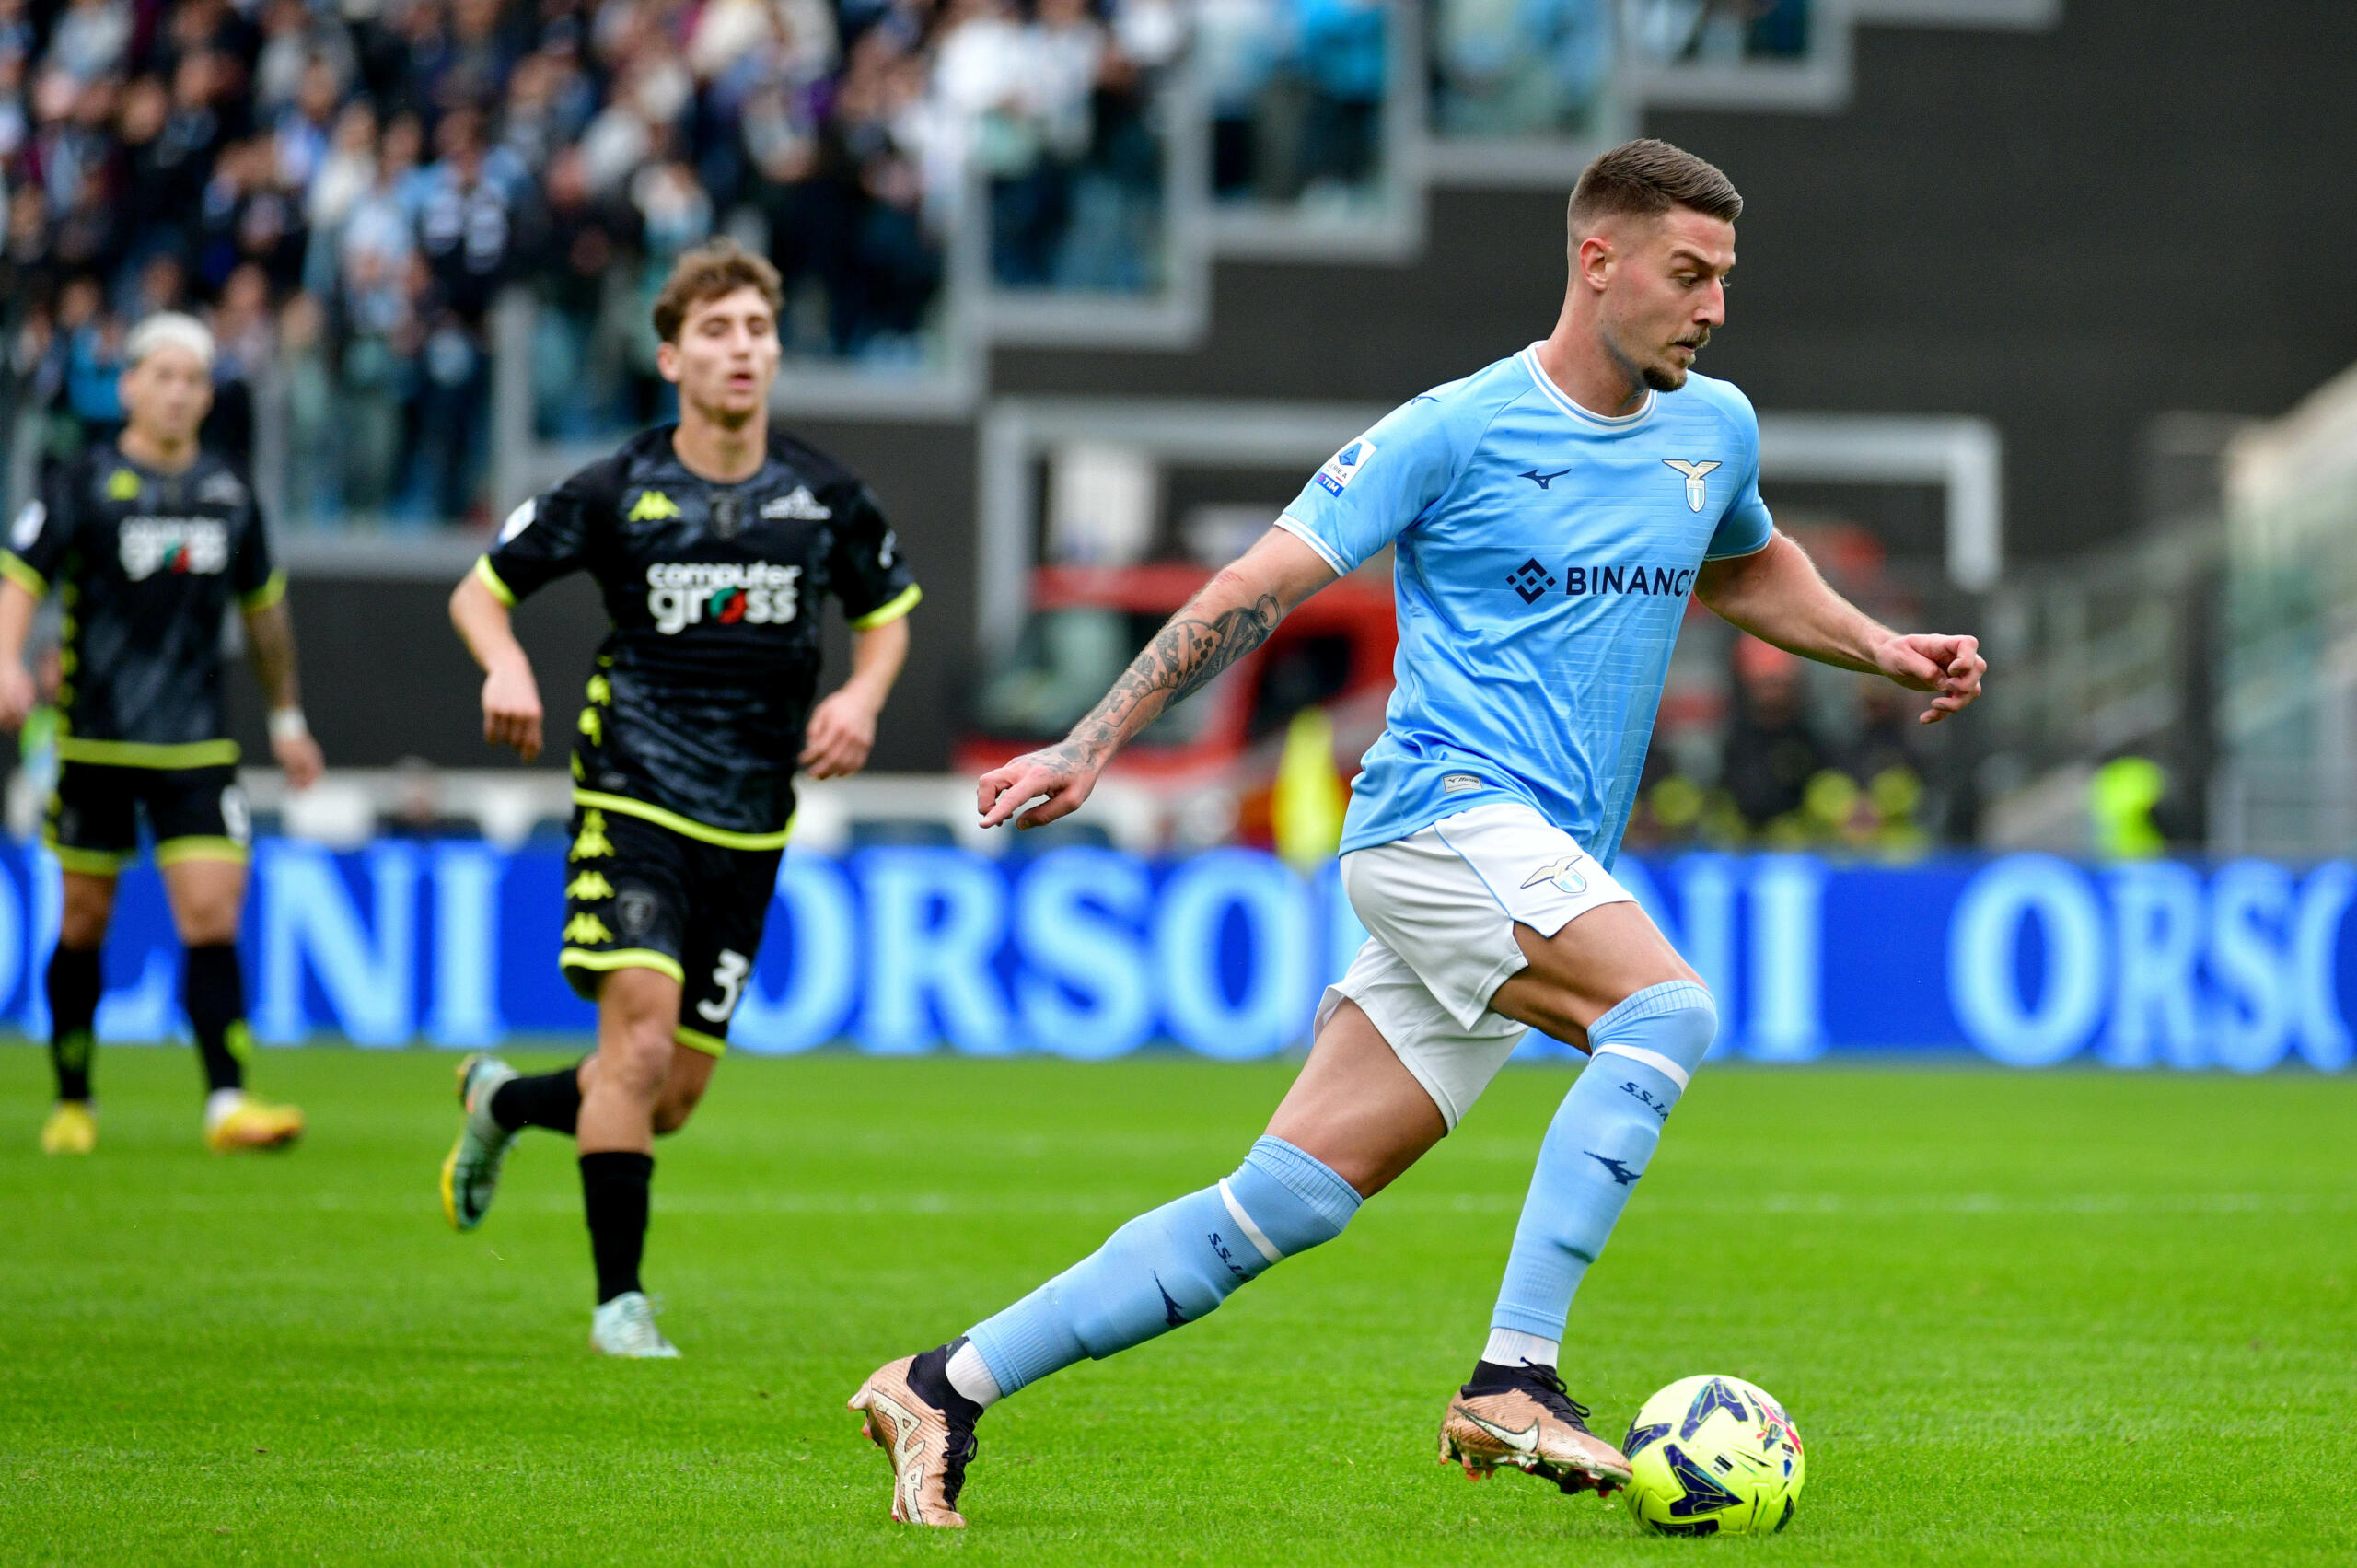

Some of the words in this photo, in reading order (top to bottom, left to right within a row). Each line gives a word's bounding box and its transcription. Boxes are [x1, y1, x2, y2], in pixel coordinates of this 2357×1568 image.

[1322, 477, 1340, 493] TIM
[646, 560, 802, 590] computer
[648, 587, 798, 635] gross
